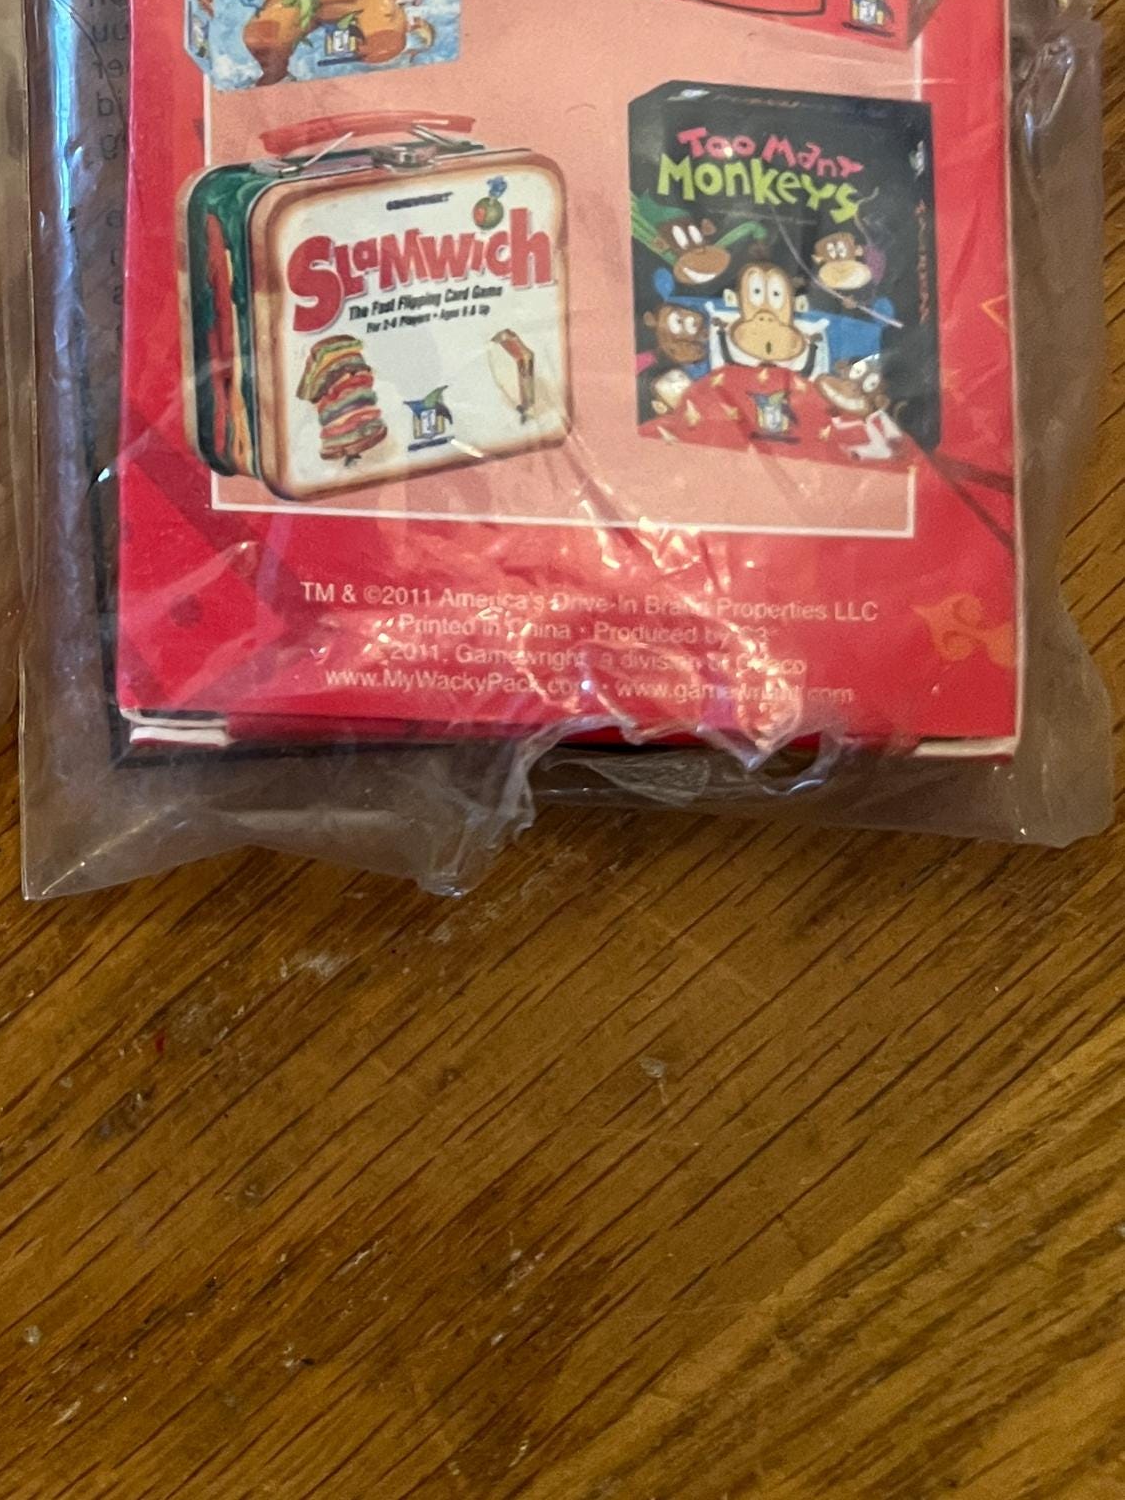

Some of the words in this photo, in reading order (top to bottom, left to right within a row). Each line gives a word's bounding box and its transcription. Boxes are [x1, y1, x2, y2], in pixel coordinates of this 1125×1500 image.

[657, 153, 860, 224] Monkeys
[300, 581, 335, 602] TM
[342, 583, 357, 603] &
[364, 585, 430, 606] ©2011
[439, 587, 545, 612] America's
[834, 601, 879, 622] LLC
[398, 613, 476, 636] Printed
[594, 621, 698, 644] Produced
